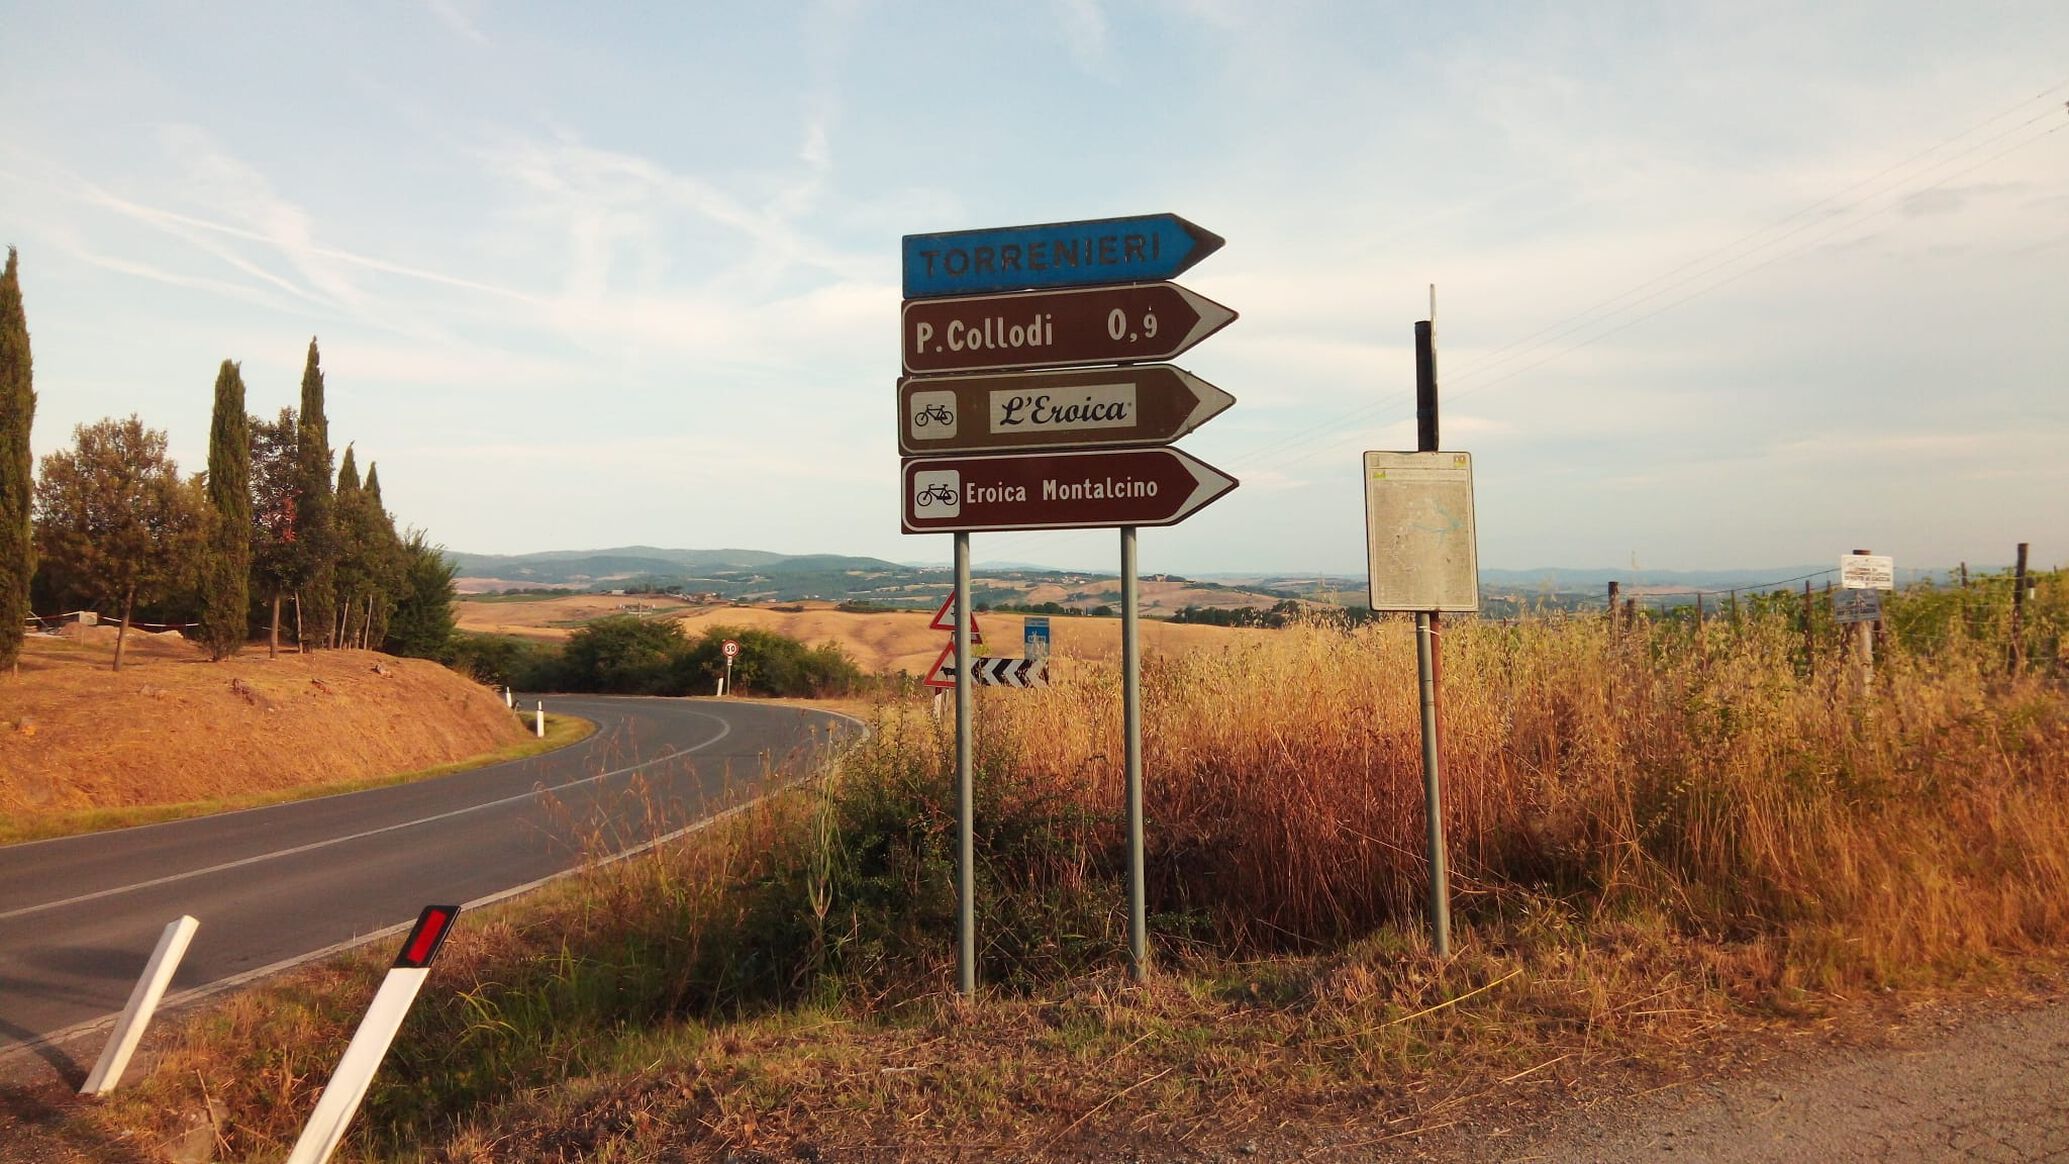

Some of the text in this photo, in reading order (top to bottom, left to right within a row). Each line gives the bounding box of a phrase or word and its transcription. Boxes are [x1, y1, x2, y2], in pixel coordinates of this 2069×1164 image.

[920, 233, 1160, 277] TORRENIERI
[1107, 308, 1158, 342] 0,9
[1000, 395, 1128, 426] L'Eroica
[966, 476, 1159, 503] Eroica Montalcino
